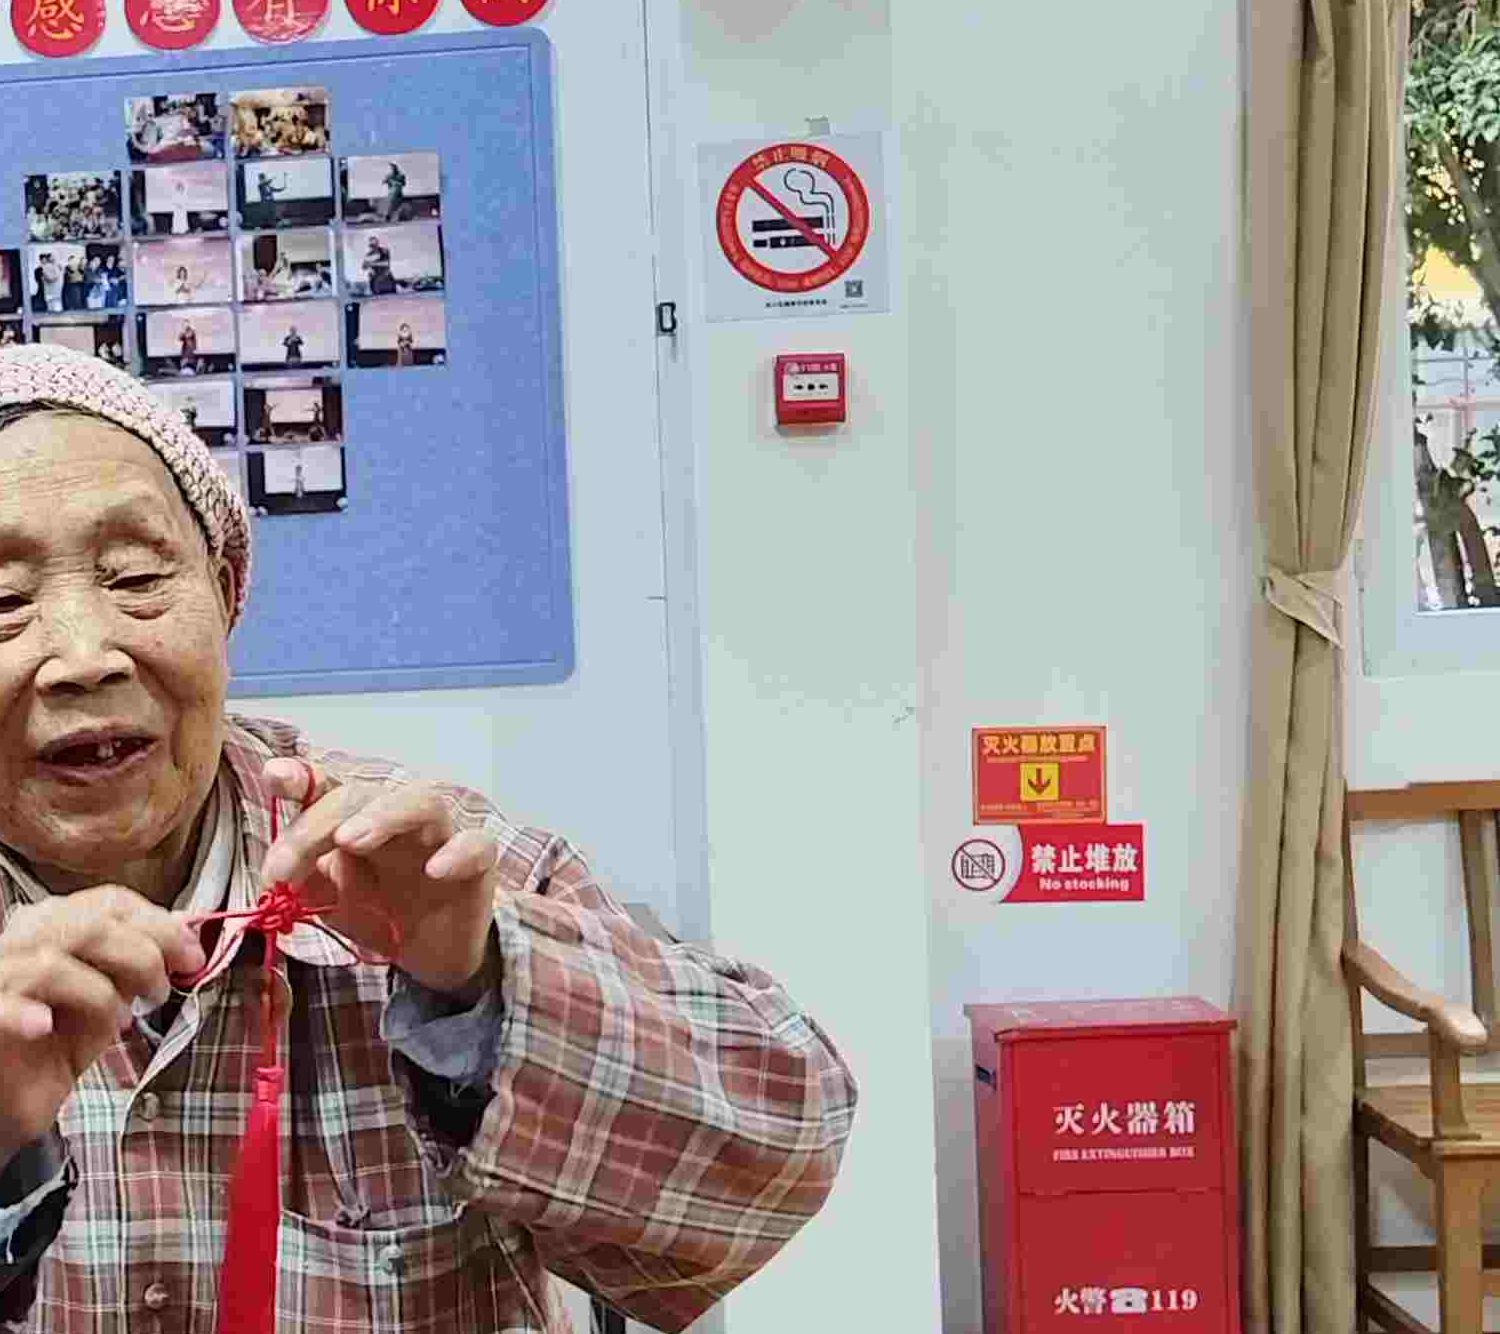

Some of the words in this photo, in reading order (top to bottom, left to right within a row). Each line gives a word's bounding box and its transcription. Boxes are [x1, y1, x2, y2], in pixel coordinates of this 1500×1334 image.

[1031, 843, 1138, 874] 禁止堆放
[1039, 877, 1062, 890] No
[1053, 1100, 1196, 1136] 灭火器箱
[1053, 1286, 1108, 1316] 火警
[1151, 1288, 1199, 1312] 119
